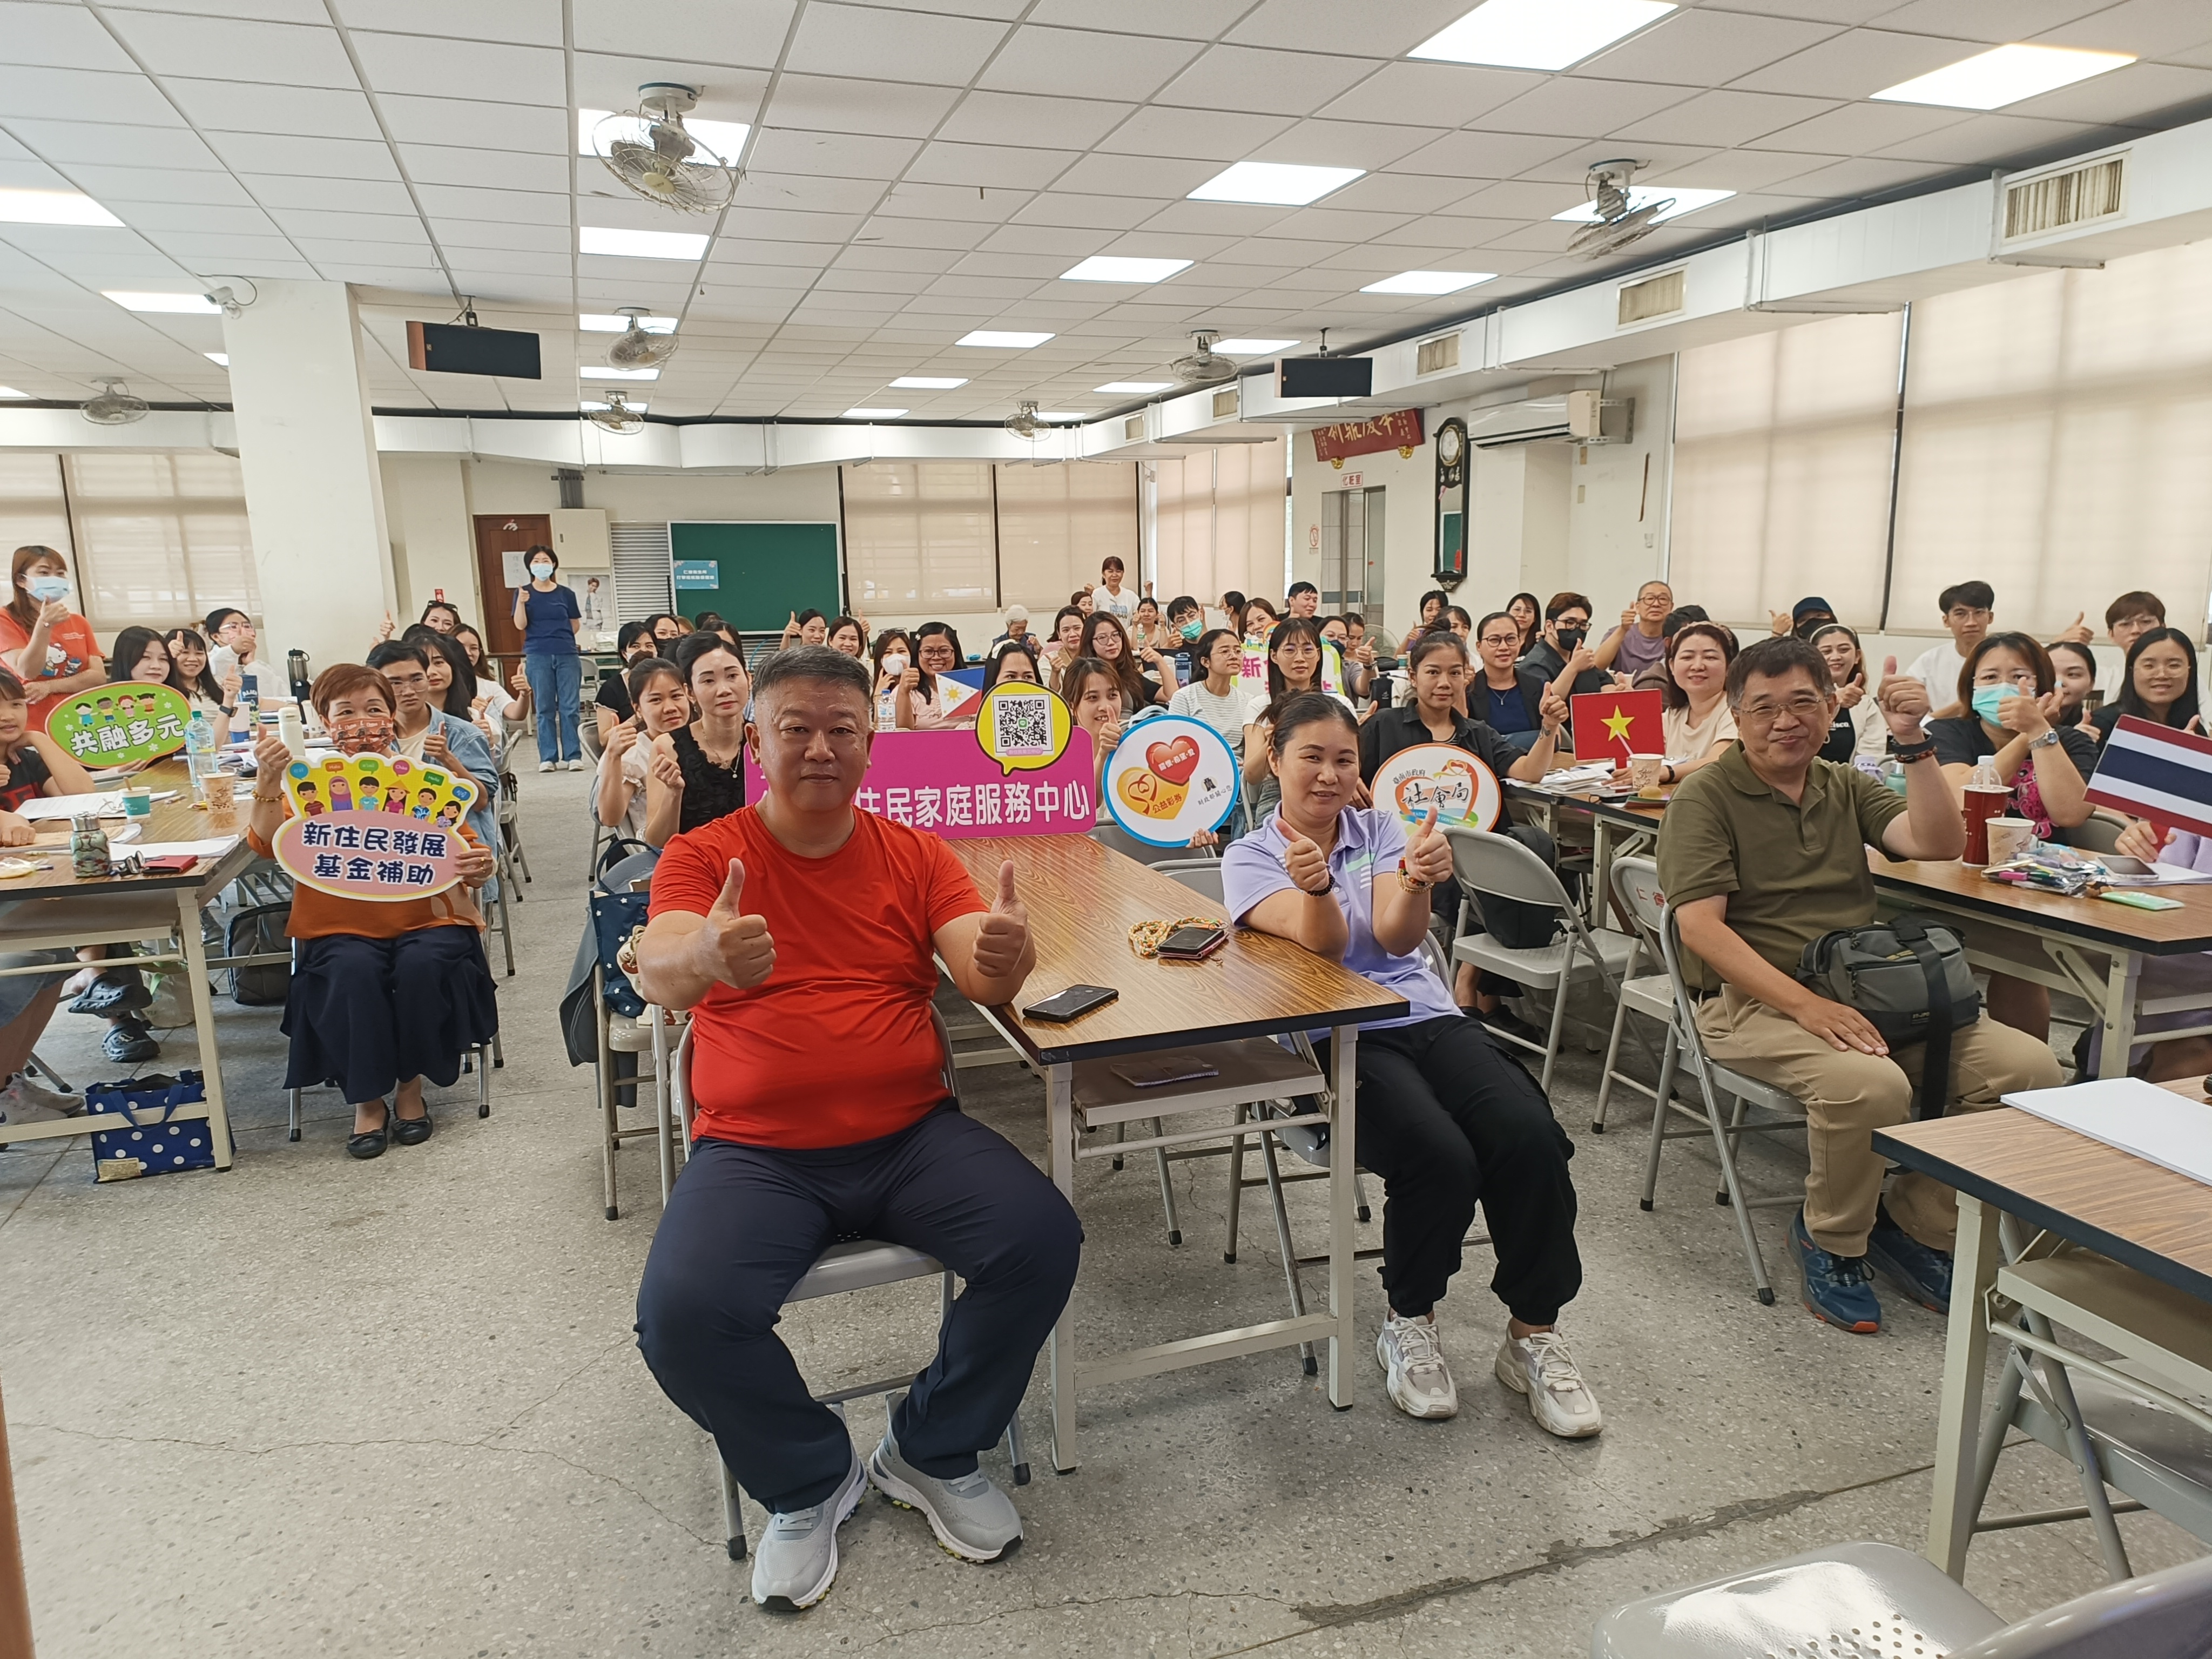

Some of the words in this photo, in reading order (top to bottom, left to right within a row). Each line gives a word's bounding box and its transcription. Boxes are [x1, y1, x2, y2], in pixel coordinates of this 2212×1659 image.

[70, 713, 184, 757] 共融多元
[1152, 793, 1182, 814] 公益彩券
[1402, 783, 1469, 808] 社會局
[303, 821, 446, 858] 新住民發展
[314, 854, 434, 885] 基金補助
